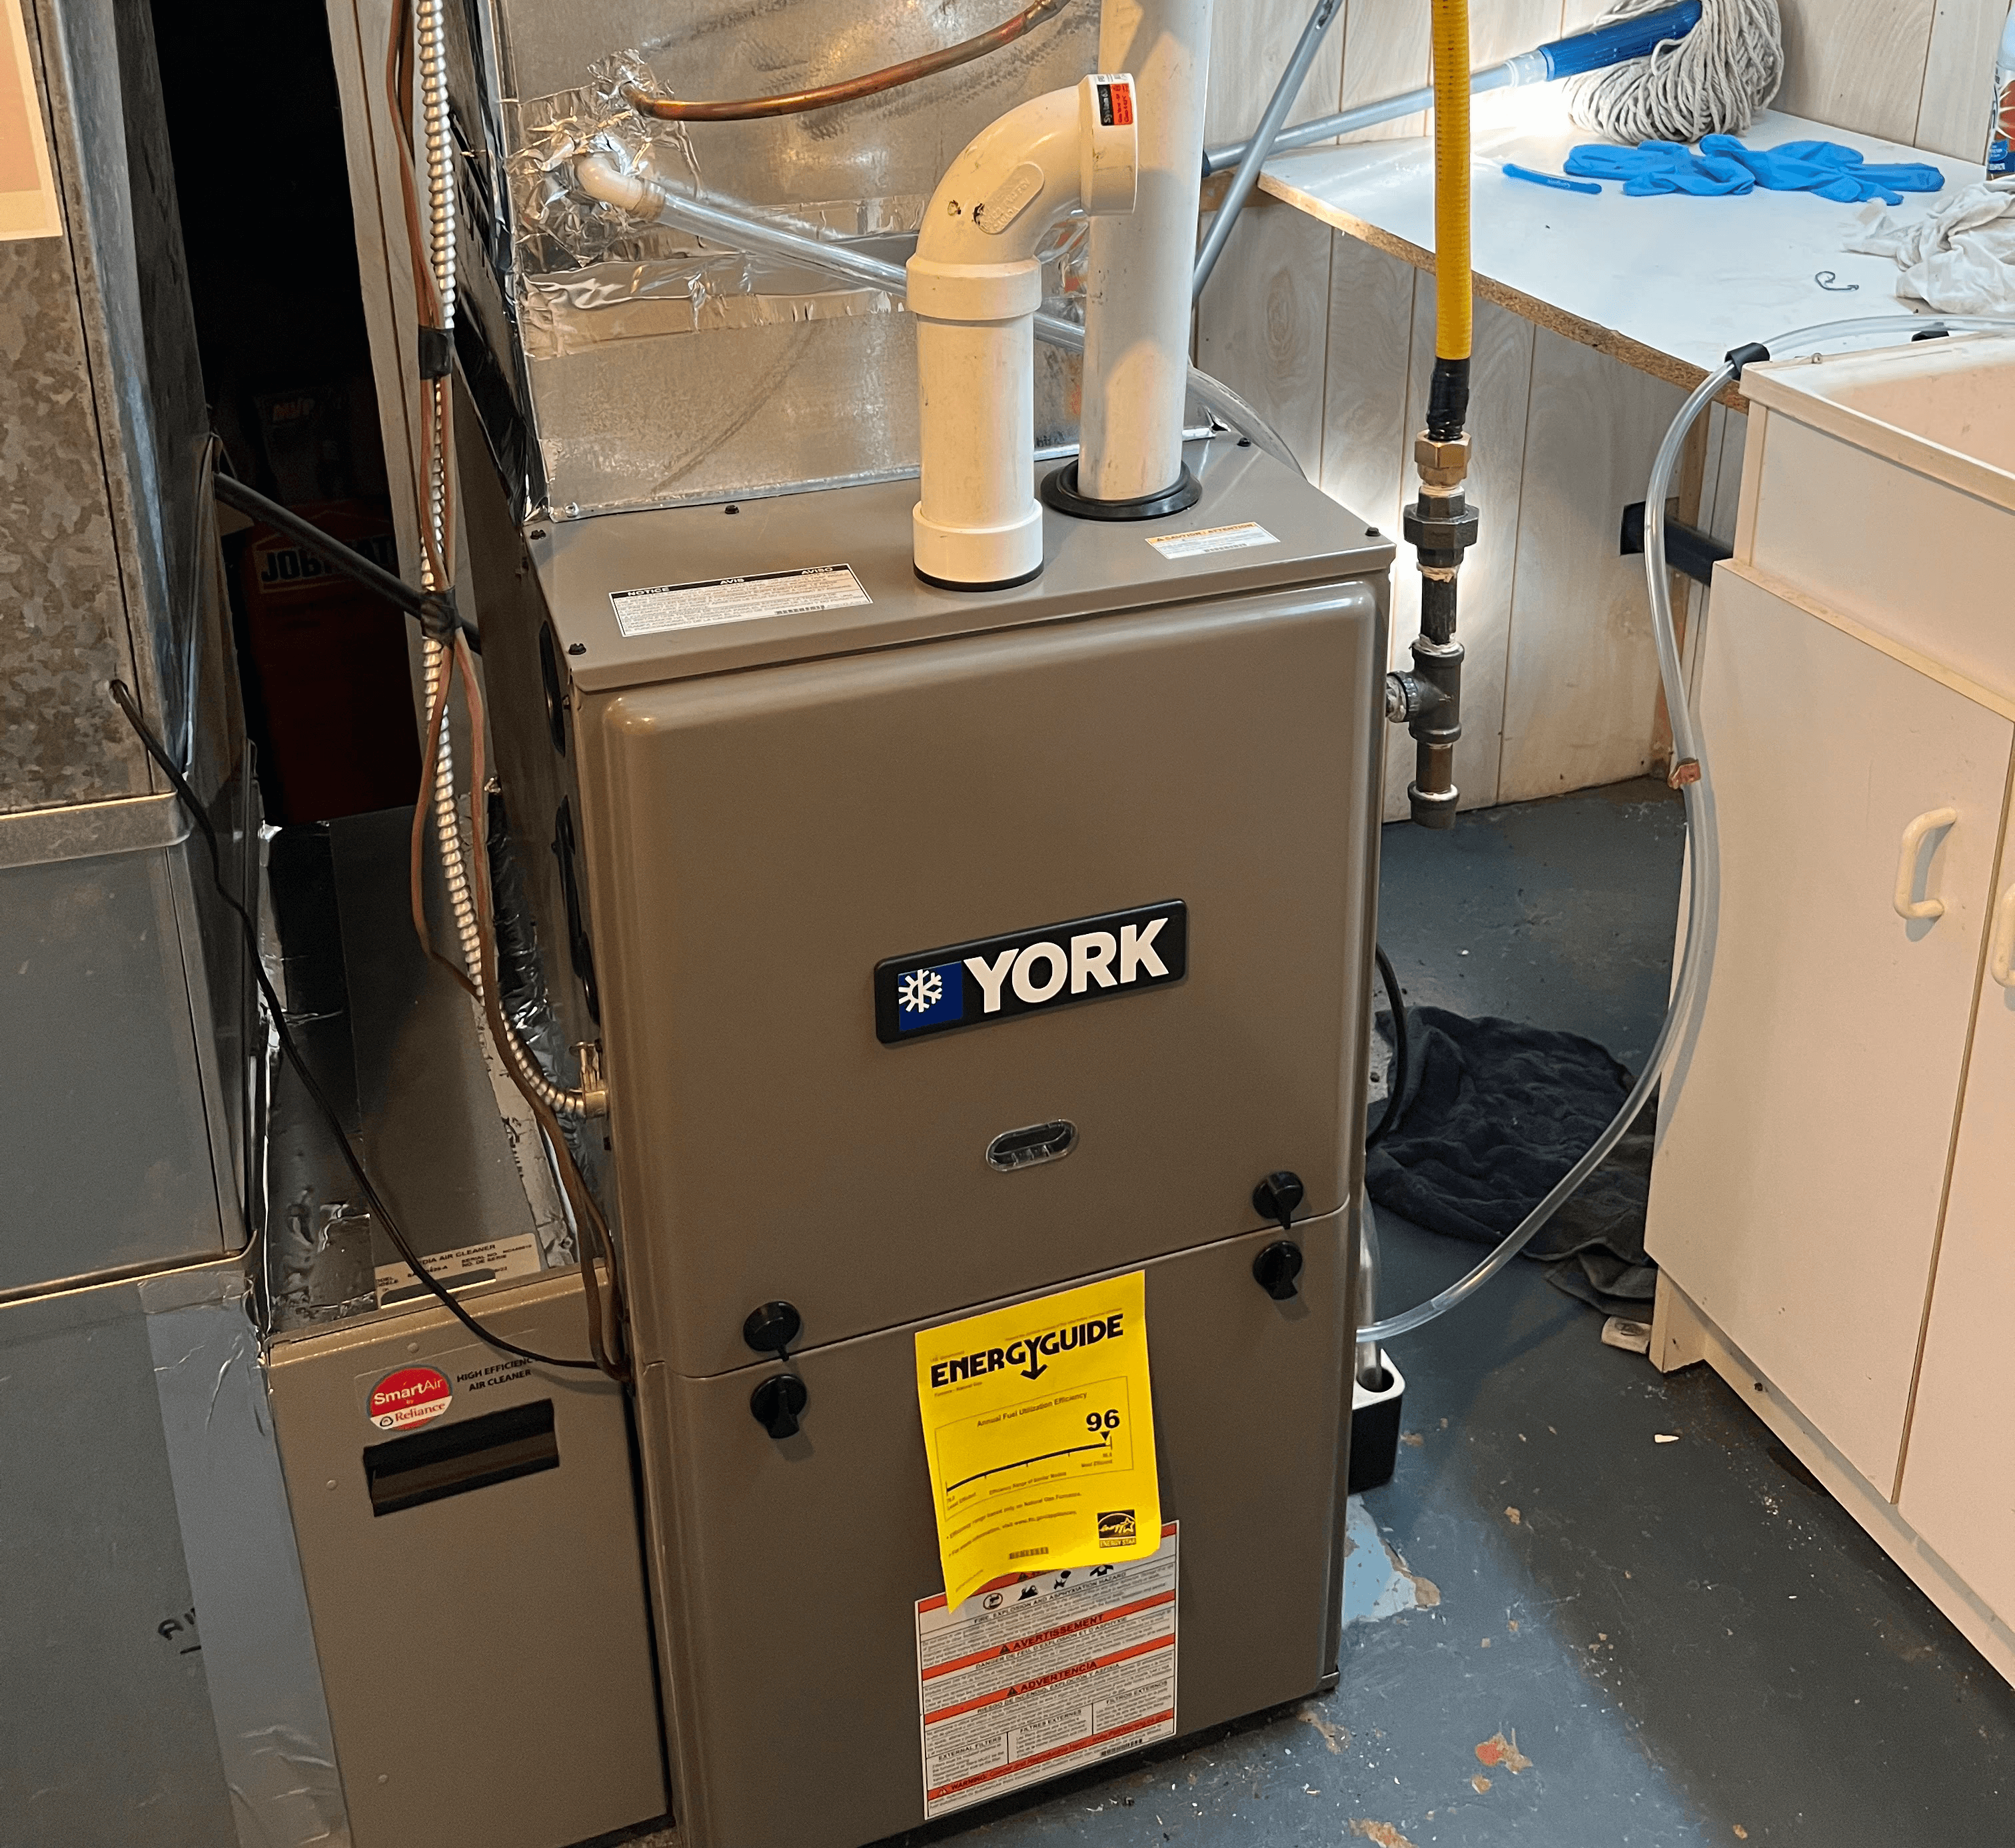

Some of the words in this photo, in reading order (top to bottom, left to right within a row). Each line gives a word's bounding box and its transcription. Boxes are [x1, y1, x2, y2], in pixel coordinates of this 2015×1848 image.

[627, 587, 670, 596] NOTICE
[963, 917, 1169, 1013] YORK
[455, 1244, 496, 1258] CLEANER
[930, 1313, 1124, 1388] ENERGYGUIDE
[456, 1370, 482, 1383] HIGH
[484, 1357, 538, 1376] EFFICIENC
[468, 1380, 486, 1392] AIR
[487, 1369, 532, 1386] CLEANER
[373, 1378, 443, 1406] SmartAir
[394, 1402, 446, 1422] Reliance
[977, 1414, 1002, 1428] Annual
[1002, 1410, 1018, 1420] Fuel
[1019, 1401, 1053, 1416] Utilization
[1053, 1392, 1088, 1406] Efficiency
[1085, 1408, 1120, 1432] 96
[1013, 1614, 1105, 1650] AVERTISSEMENT
[1020, 1661, 1099, 1692] ADVERTENCIA
[938, 1745, 974, 1761] EXTERNAL
[974, 1736, 1002, 1749] FILTERS
